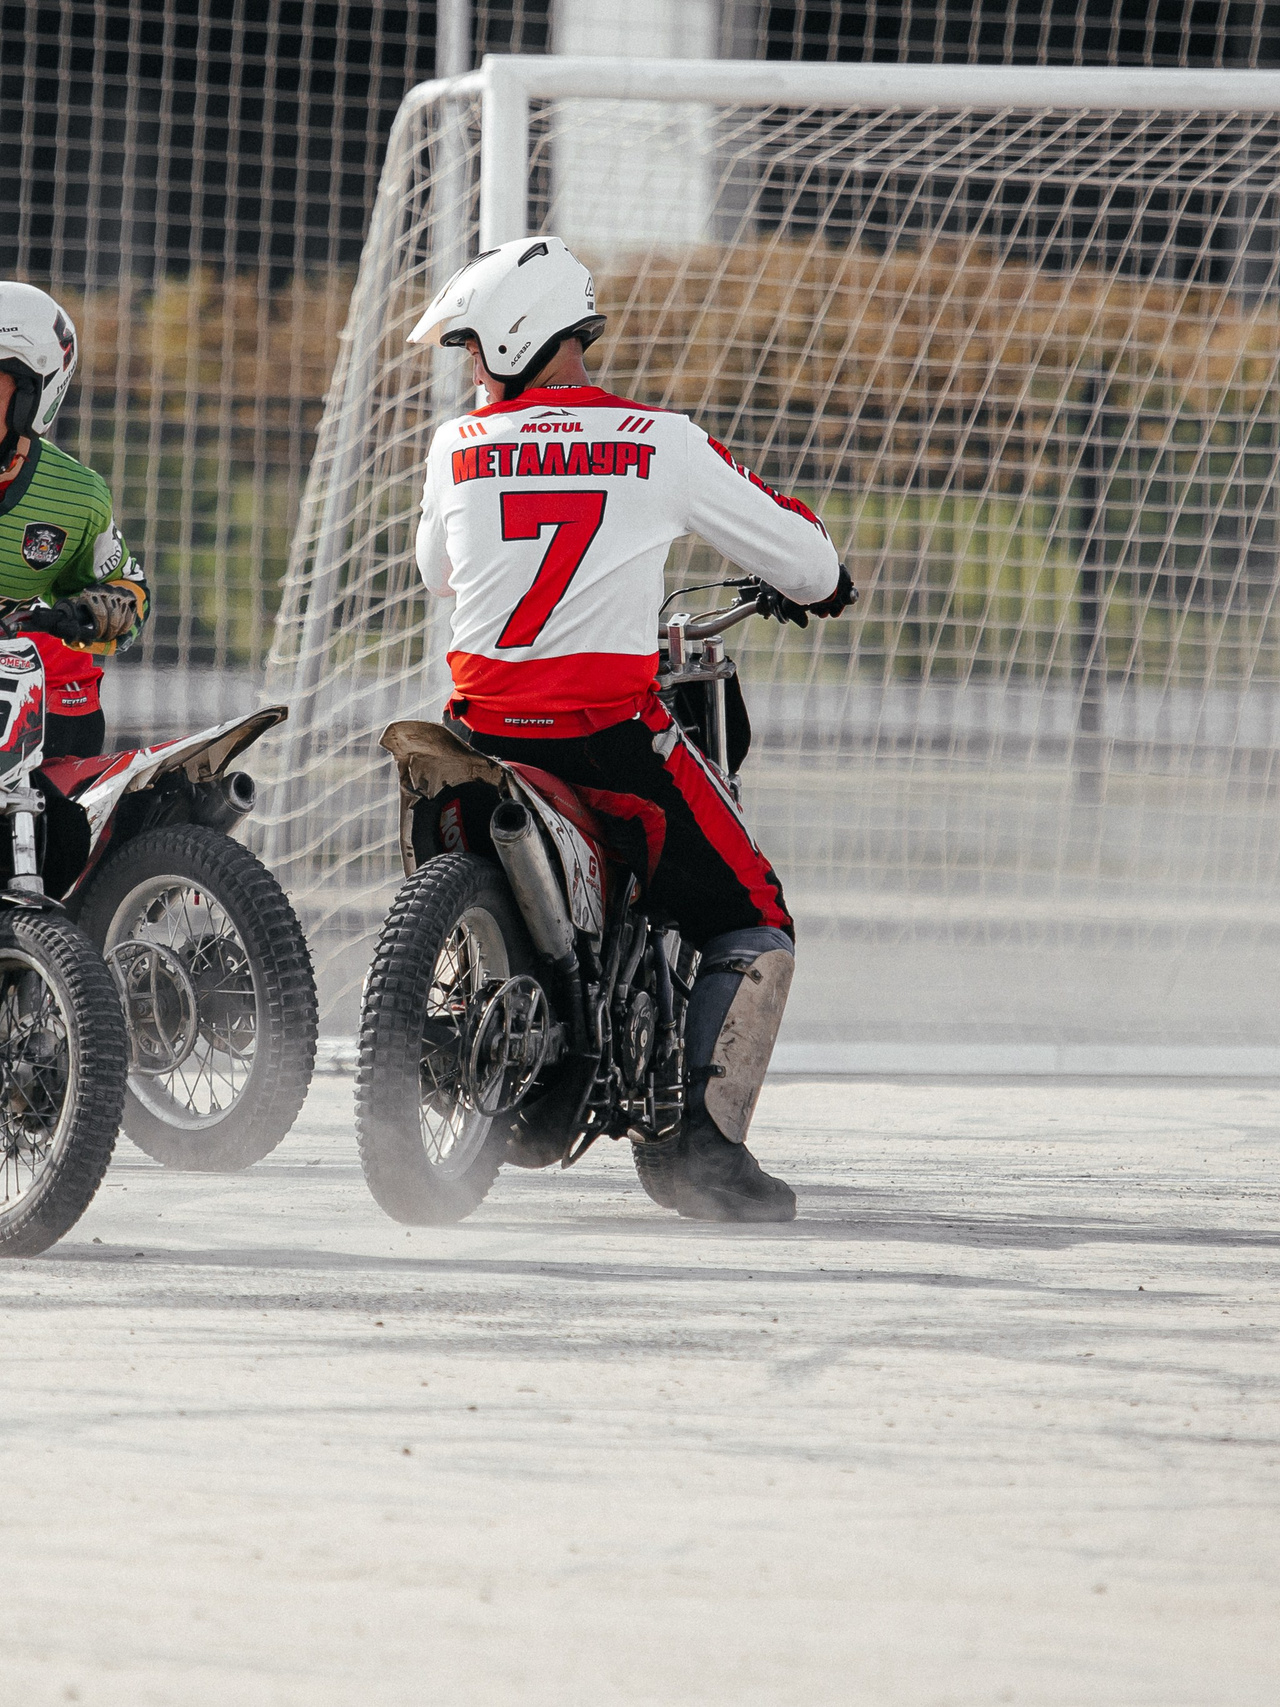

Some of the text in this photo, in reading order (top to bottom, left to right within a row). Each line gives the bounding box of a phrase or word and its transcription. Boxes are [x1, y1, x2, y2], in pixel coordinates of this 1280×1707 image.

[520, 421, 584, 433] MOTUL
[451, 441, 657, 486] МЕТАЛЛУРГ
[495, 490, 608, 649] 7
